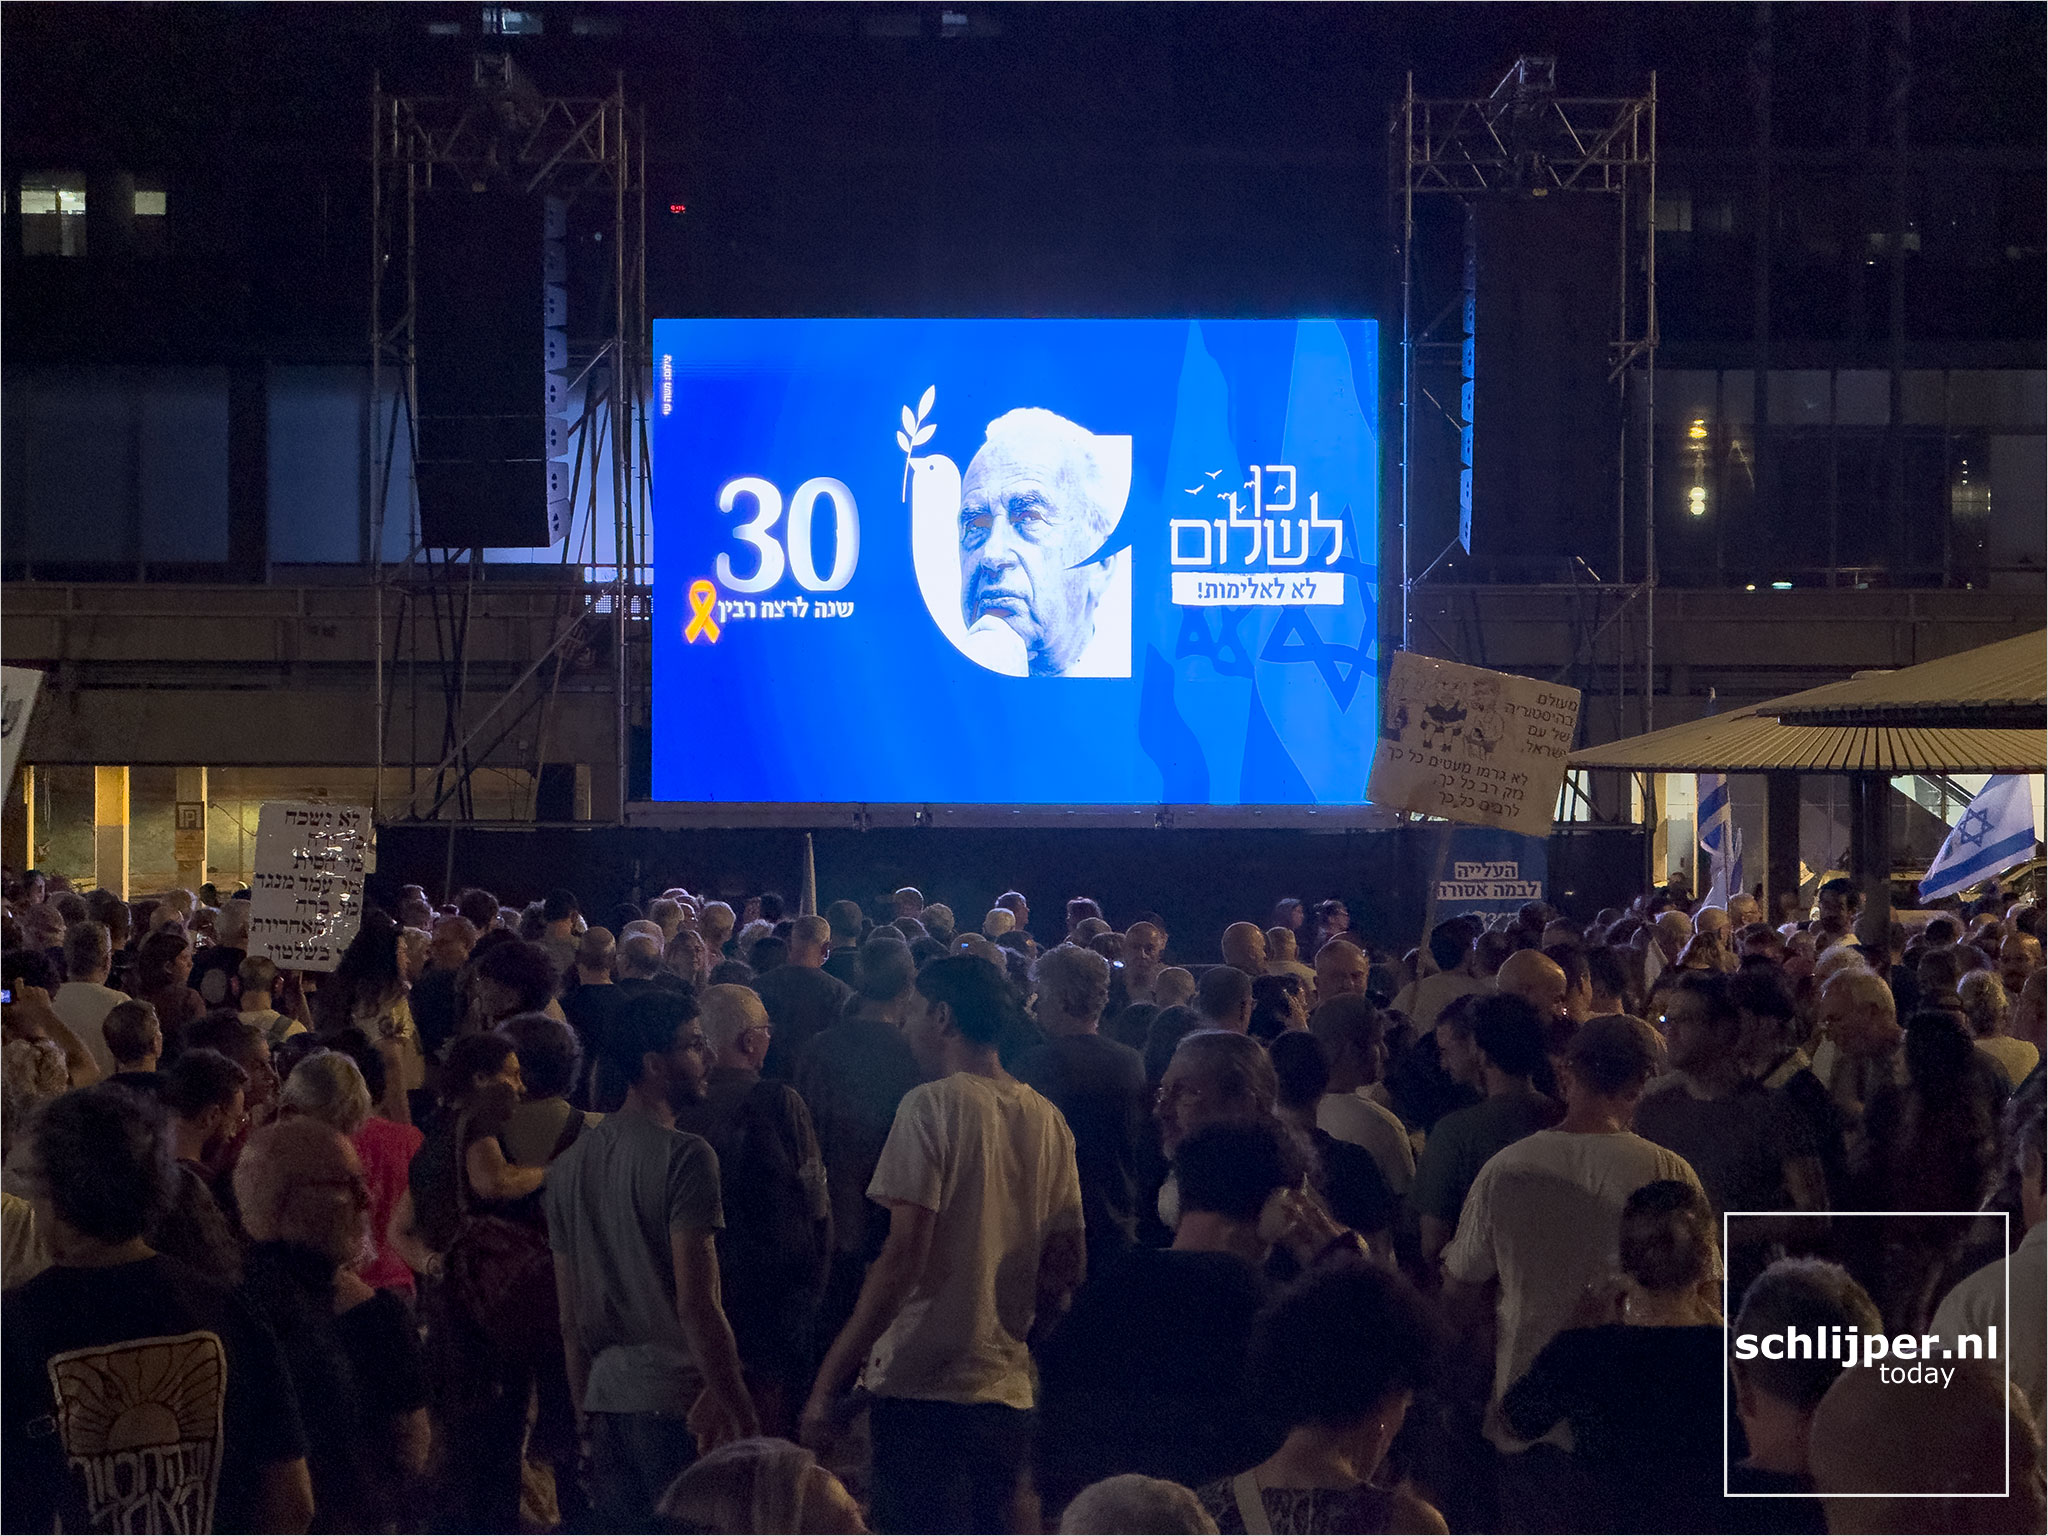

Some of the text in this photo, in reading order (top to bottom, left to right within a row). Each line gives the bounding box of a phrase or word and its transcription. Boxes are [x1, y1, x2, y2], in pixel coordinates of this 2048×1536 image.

[663, 382, 673, 402] משה
[1250, 465, 1296, 518] כן
[716, 477, 860, 593] 30
[1169, 491, 1343, 565] לשלום
[1197, 577, 1317, 599] לא לאלימות!
[717, 596, 854, 623] שנה לרצח רבין
[1537, 693, 1578, 711] מעולם
[1527, 724, 1571, 742] של עם
[1388, 746, 1528, 786] לא גרמו מעטים כל כך
[1460, 775, 1476, 790] כל
[1479, 781, 1498, 795] רב
[1438, 791, 1521, 818] לרבים כל כך
[285, 809, 360, 827] לא נשכח
[344, 856, 363, 872] מי
[1457, 861, 1517, 878] העלייה
[255, 873, 295, 890] מנגד
[299, 876, 333, 895] עמד
[1494, 881, 1538, 897] לבמה
[251, 917, 328, 935] מאחריות
[267, 941, 330, 961] בשלטון
